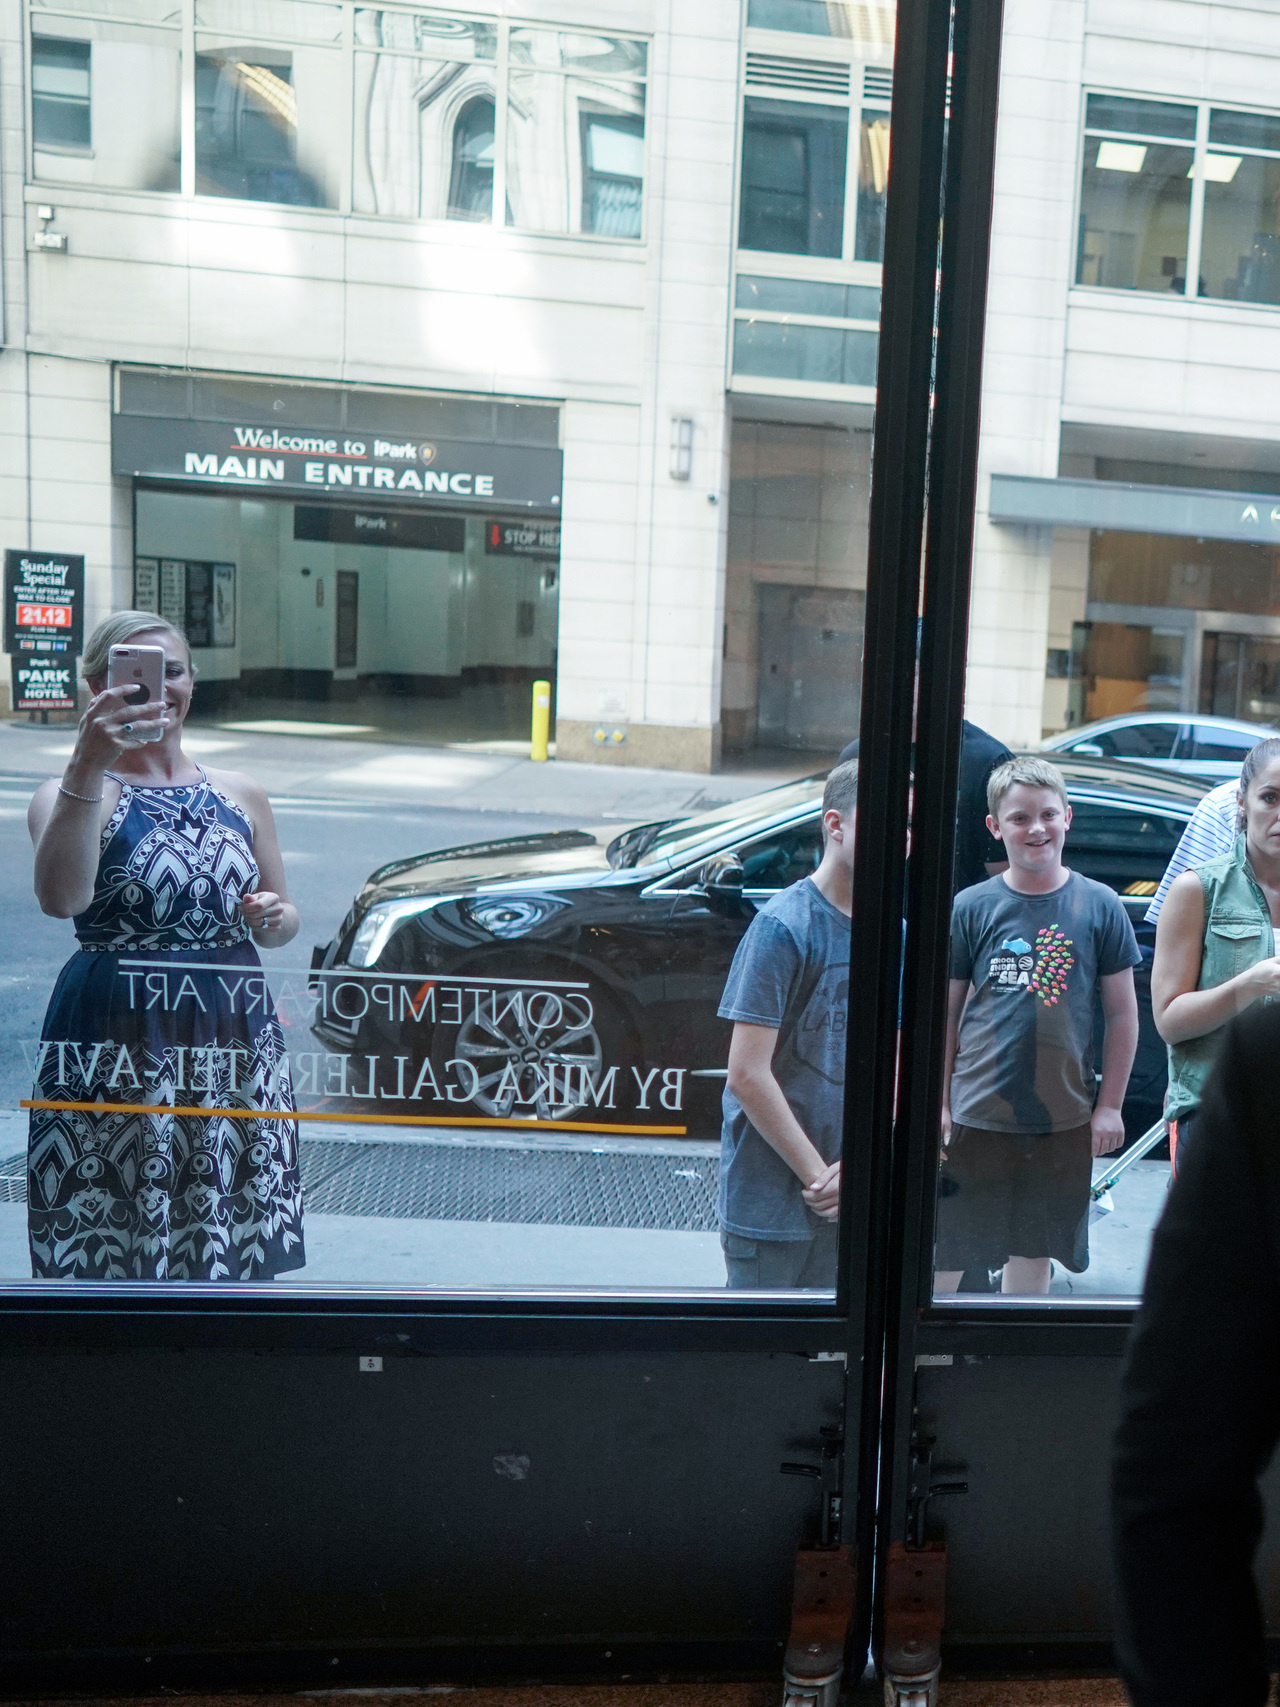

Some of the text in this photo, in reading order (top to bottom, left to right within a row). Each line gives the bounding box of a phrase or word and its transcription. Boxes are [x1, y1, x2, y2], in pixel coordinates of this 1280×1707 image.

[234, 427, 417, 459] Welcome to iPark
[184, 452, 494, 496] MAIN ENTRANCE
[355, 514, 387, 530] iPark
[504, 528, 537, 546] STOP
[20, 559, 69, 577] Sunday
[23, 571, 66, 586] Special
[22, 607, 66, 625] 21.12
[18, 669, 71, 683] PARK
[25, 688, 69, 699] HOTEL
[998, 971, 1030, 985] SEA
